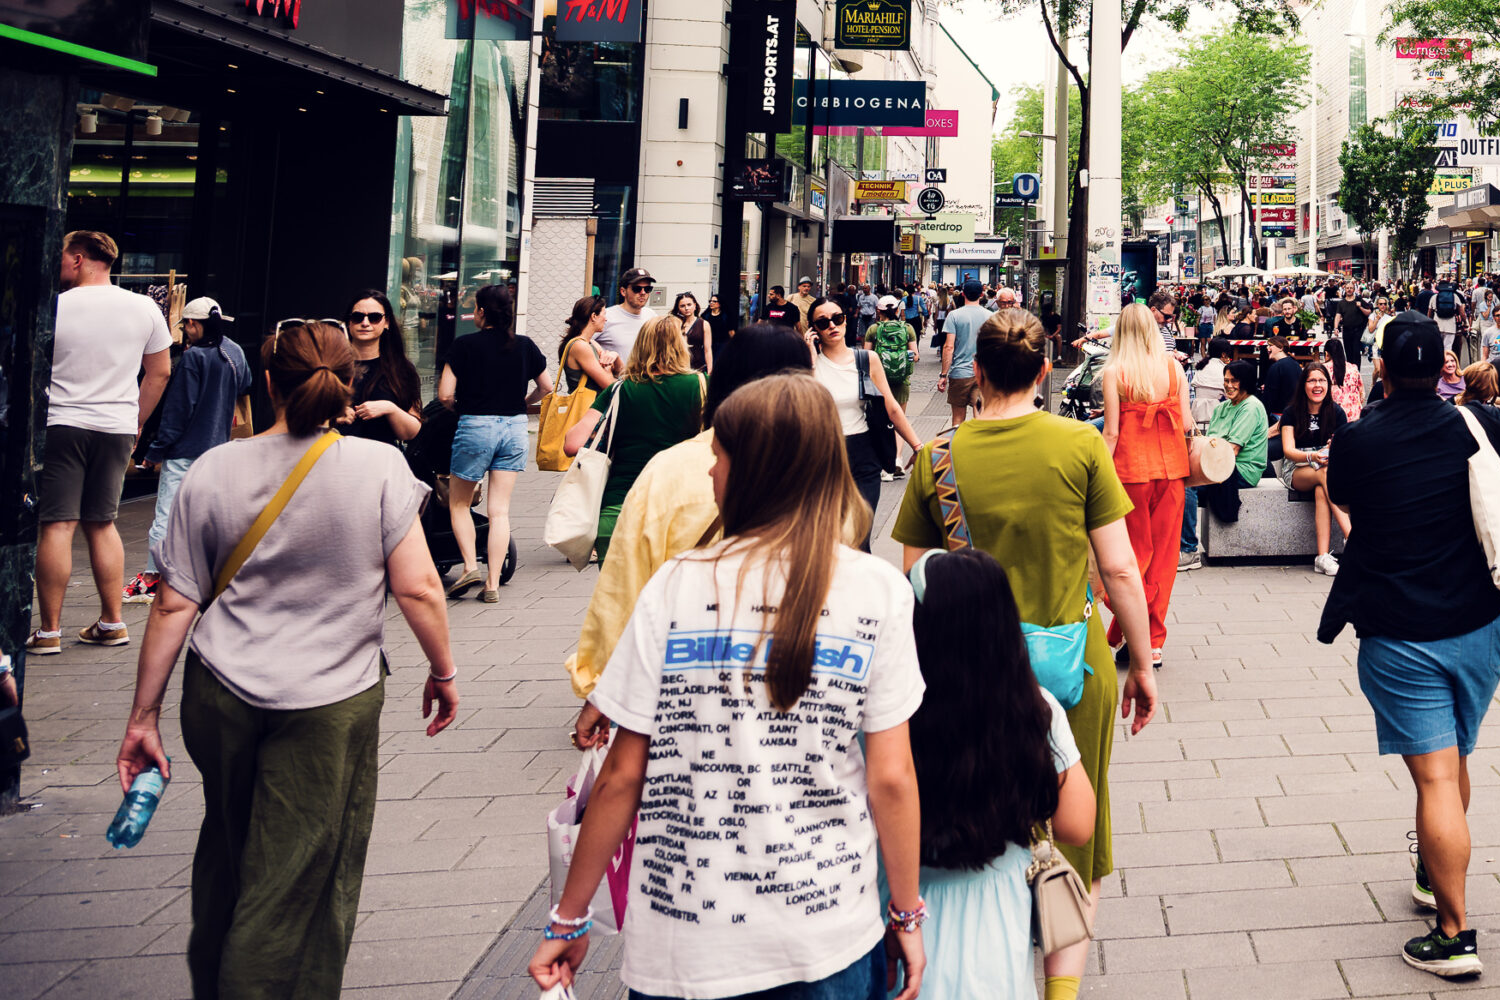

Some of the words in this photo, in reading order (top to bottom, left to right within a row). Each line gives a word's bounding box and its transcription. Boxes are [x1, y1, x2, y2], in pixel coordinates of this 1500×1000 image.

[845, 9, 904, 24] MARIAHILF
[763, 15, 780, 115] JDSPORTS.AT
[832, 96, 922, 109] BIOGENA
[860, 182, 893, 190] TECHNIK
[1250, 176, 1273, 184] LOALE
[1444, 181, 1468, 189] PLUS
[1017, 178, 1035, 197] U
[1250, 194, 1277, 203] BLLA
[665, 636, 756, 665] Billie
[757, 711, 803, 723] ATLANTA,
[716, 723, 730, 733] OH
[768, 724, 798, 734] SAINT
[701, 750, 715, 760] NE
[771, 763, 812, 775] SEATTLE,
[737, 778, 751, 788] OR
[790, 776, 817, 788] JOSE,
[704, 790, 718, 800] AZ
[728, 790, 746, 801] LOS
[719, 817, 748, 829] OSLO,
[794, 818, 848, 836] HANNOVER,
[725, 830, 740, 841] DK
[697, 858, 710, 868] DE
[686, 870, 696, 881] PL
[724, 871, 762, 882] VIENNA,
[764, 870, 777, 881] AT
[681, 883, 692, 894] FR
[756, 878, 818, 895] BARCELONA,
[702, 900, 717, 911] UK
[786, 888, 827, 906] LONDON,
[731, 913, 746, 924] UK
